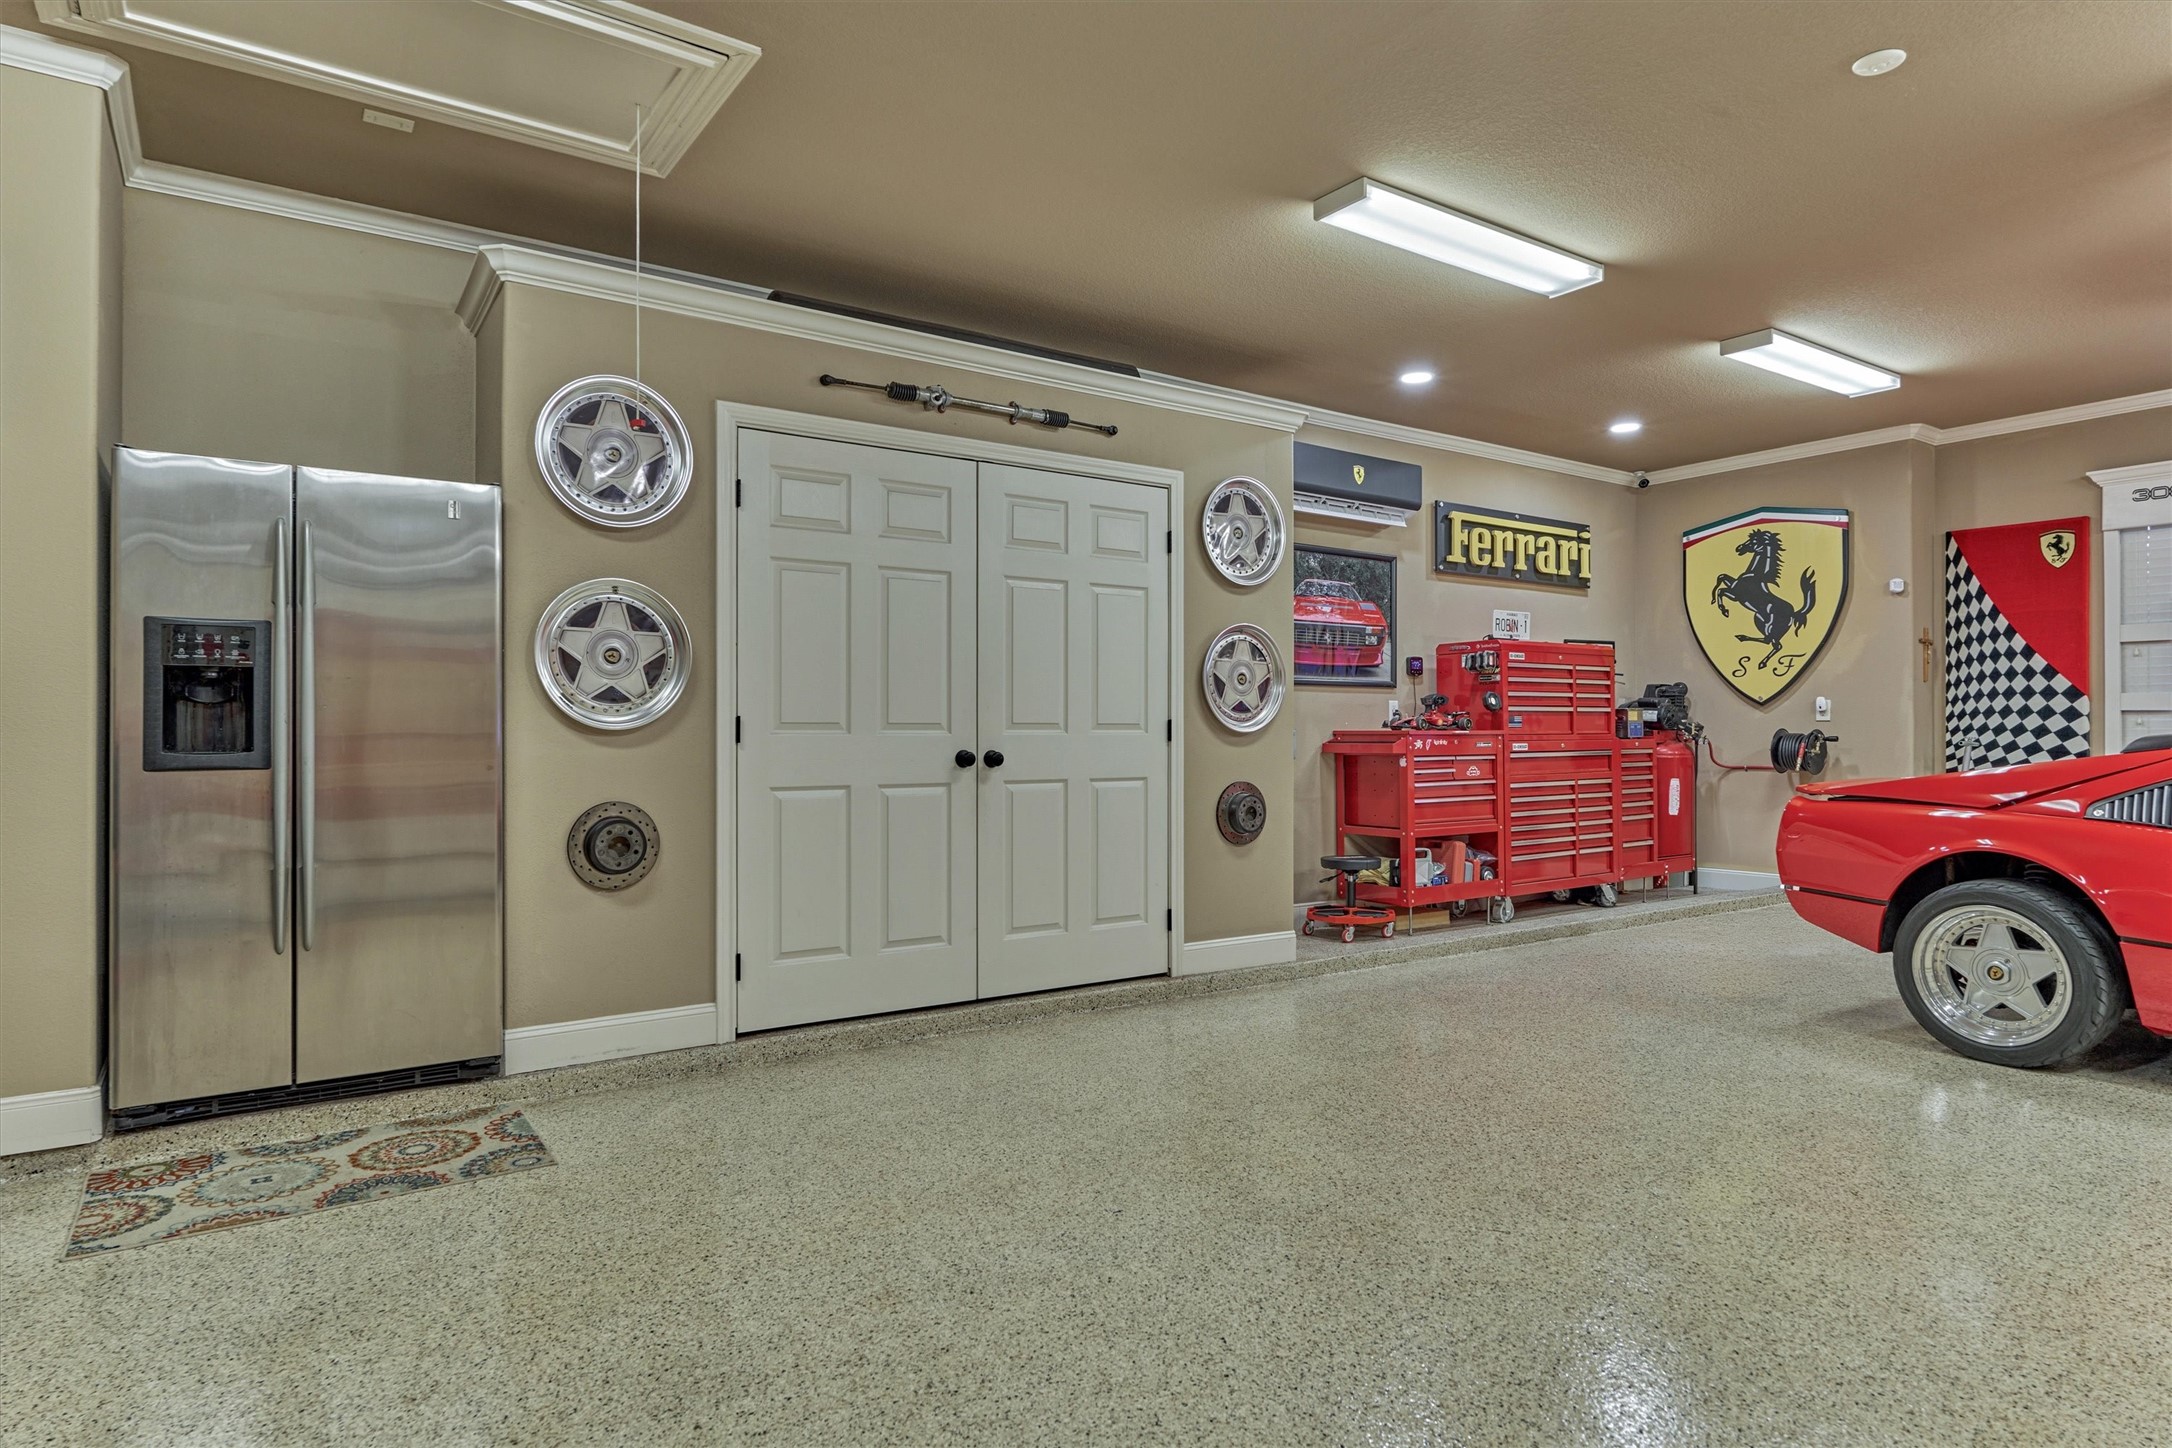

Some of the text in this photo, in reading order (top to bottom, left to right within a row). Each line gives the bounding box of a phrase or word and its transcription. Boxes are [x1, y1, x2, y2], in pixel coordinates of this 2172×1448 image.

[2131, 485, 2172, 502] 30
[1446, 511, 1592, 579] Ferrari
[1732, 652, 1807, 677] S F
